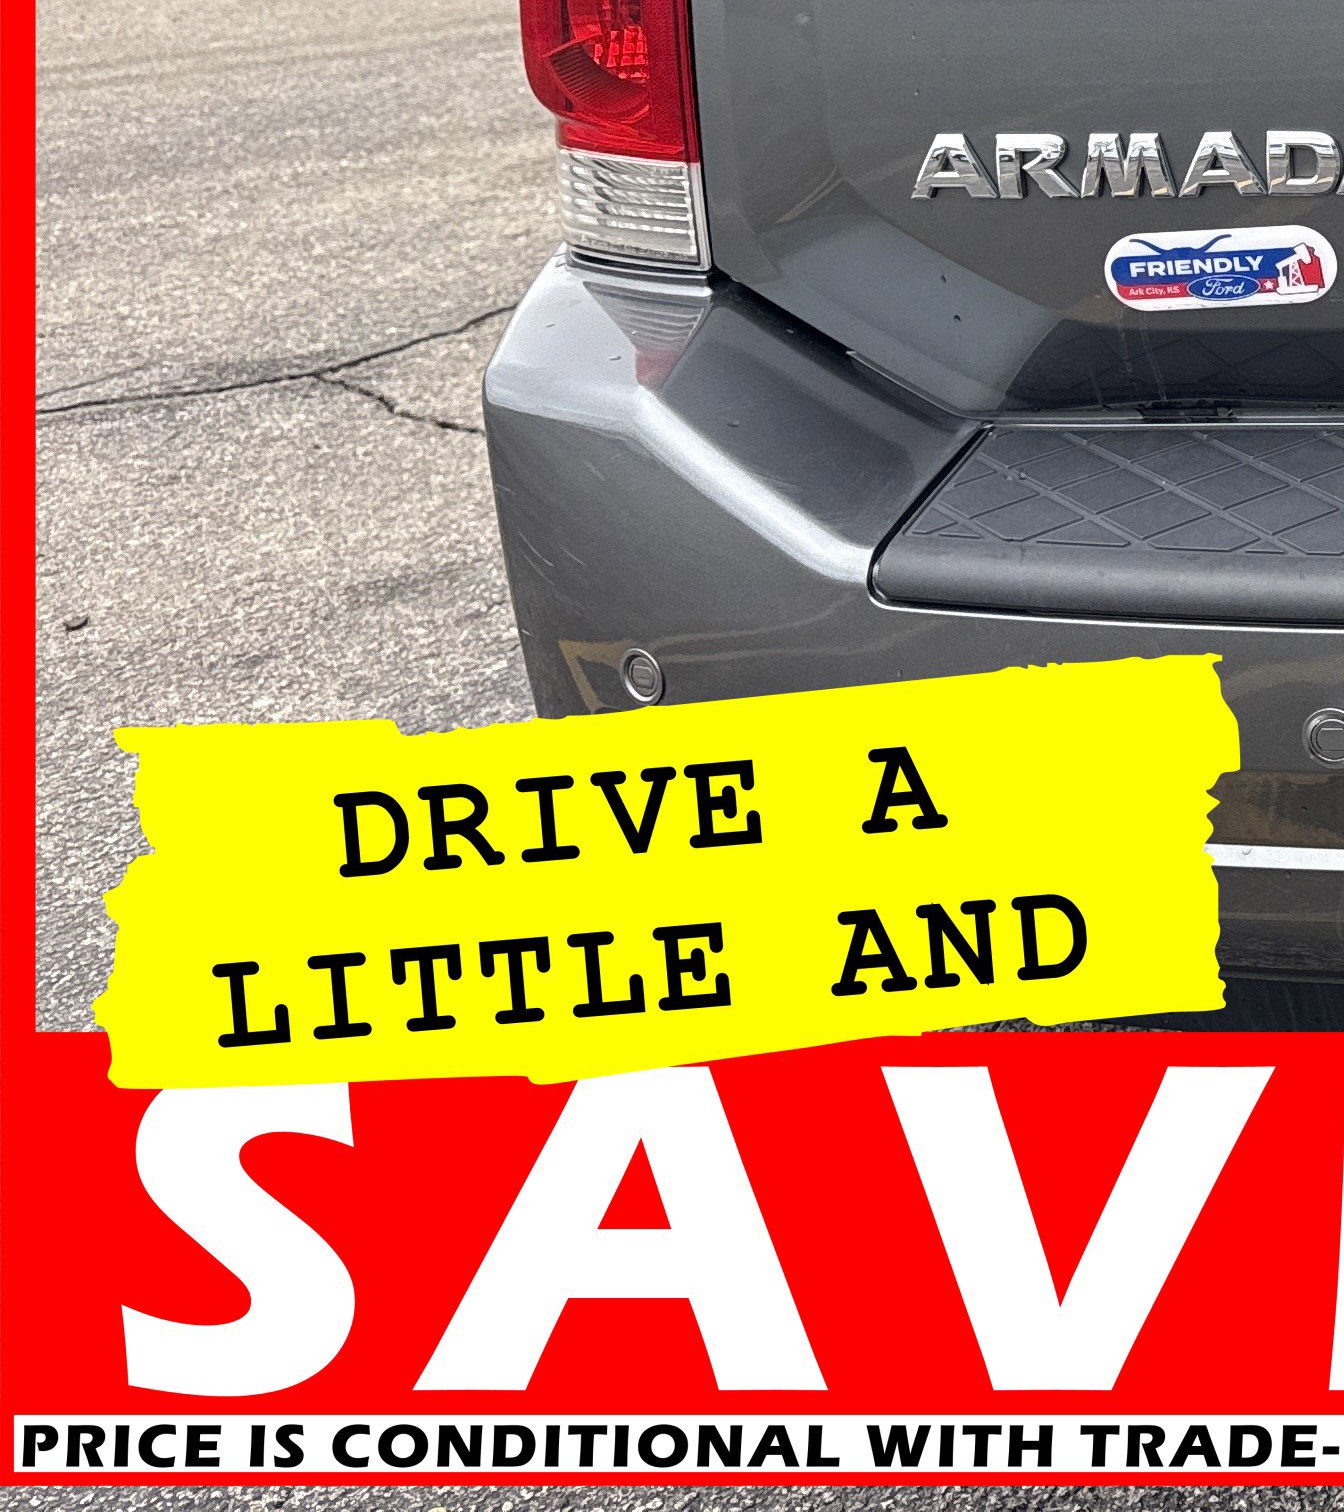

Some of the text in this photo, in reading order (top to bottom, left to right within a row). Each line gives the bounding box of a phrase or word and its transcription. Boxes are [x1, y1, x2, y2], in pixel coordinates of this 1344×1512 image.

[1129, 255, 1264, 278] FRIENDLY
[1128, 287, 1145, 296] Ark
[1201, 277, 1245, 296] Ford
